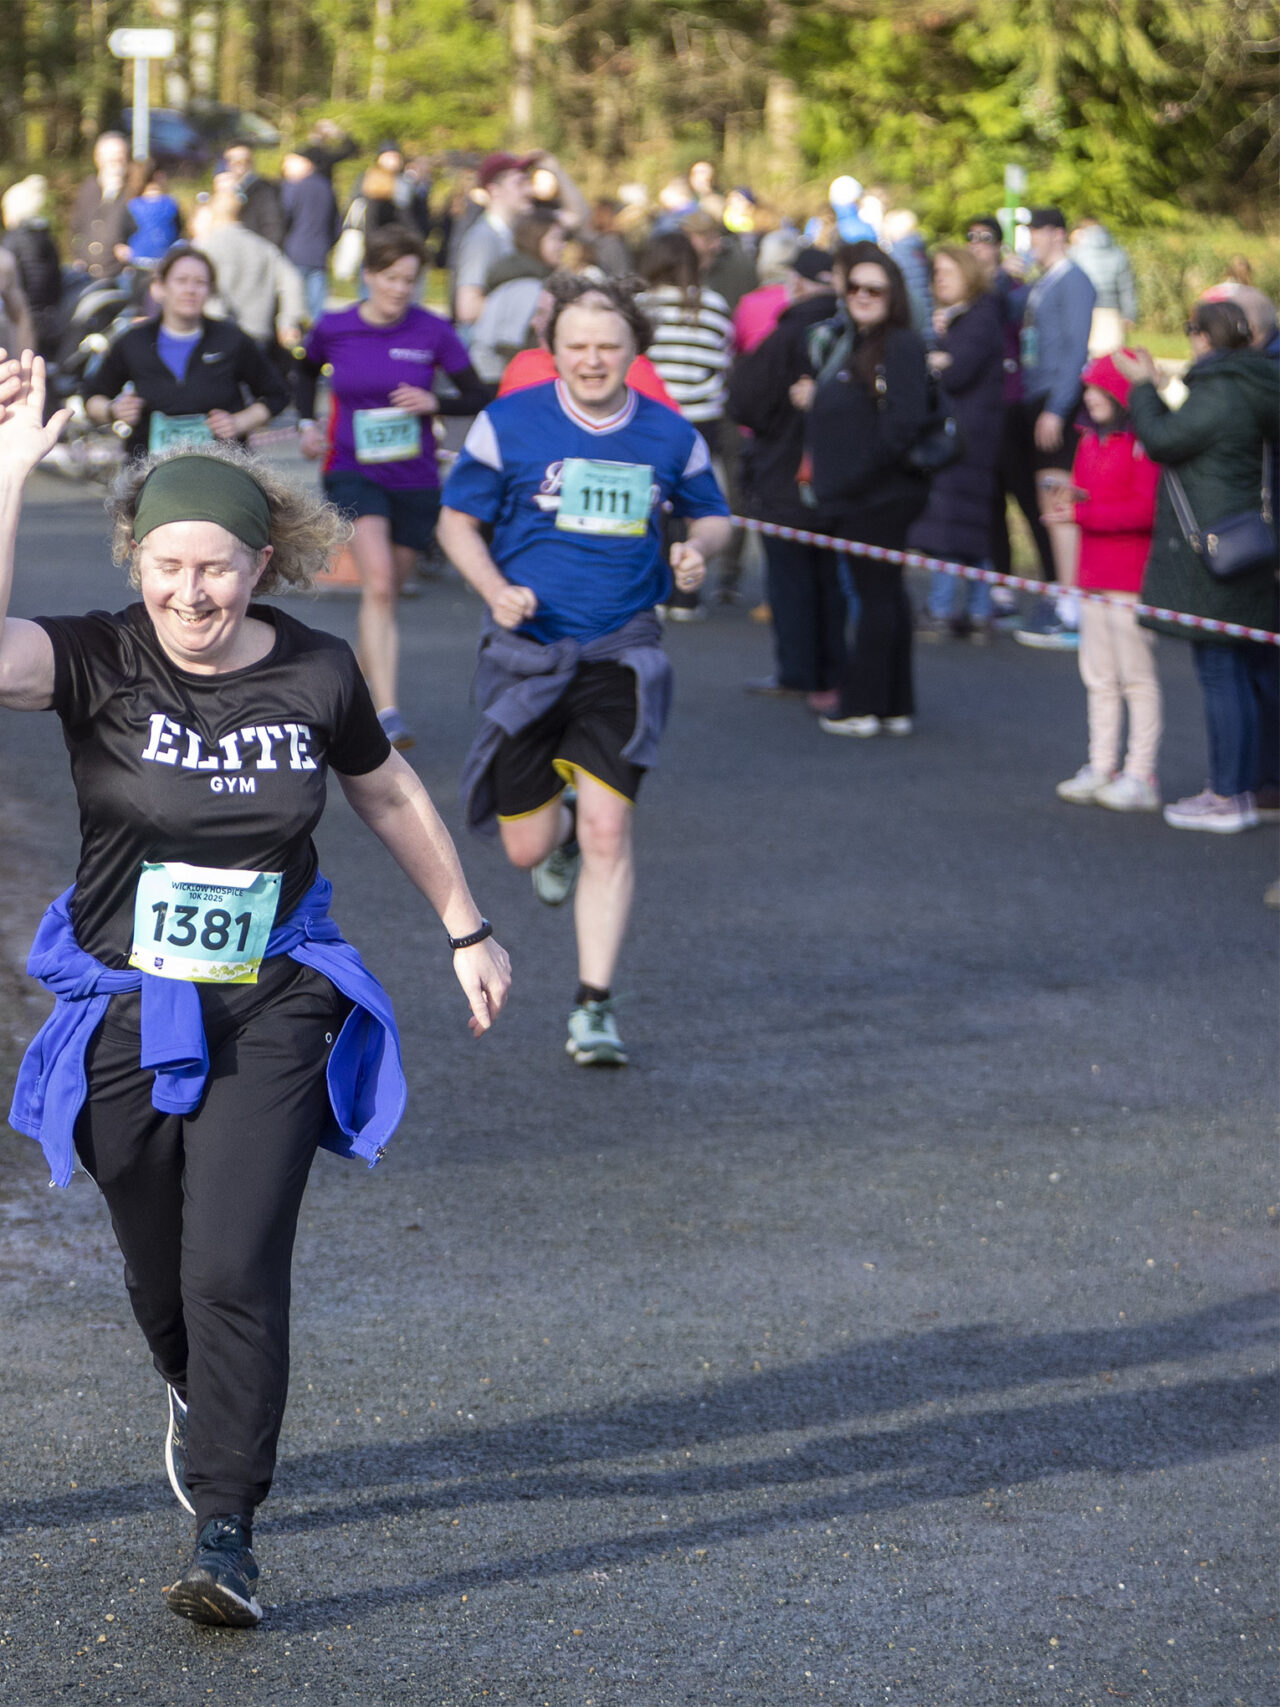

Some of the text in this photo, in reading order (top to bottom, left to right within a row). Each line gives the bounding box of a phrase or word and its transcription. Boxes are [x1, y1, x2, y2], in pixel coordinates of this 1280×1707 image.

[580, 486, 630, 514] 1111
[141, 713, 317, 769] ELITE
[210, 776, 256, 793] GYM
[171, 881, 244, 896] WICKLOW HOSPICE
[189, 892, 224, 902] 10K 2025
[151, 900, 252, 952] 1381
